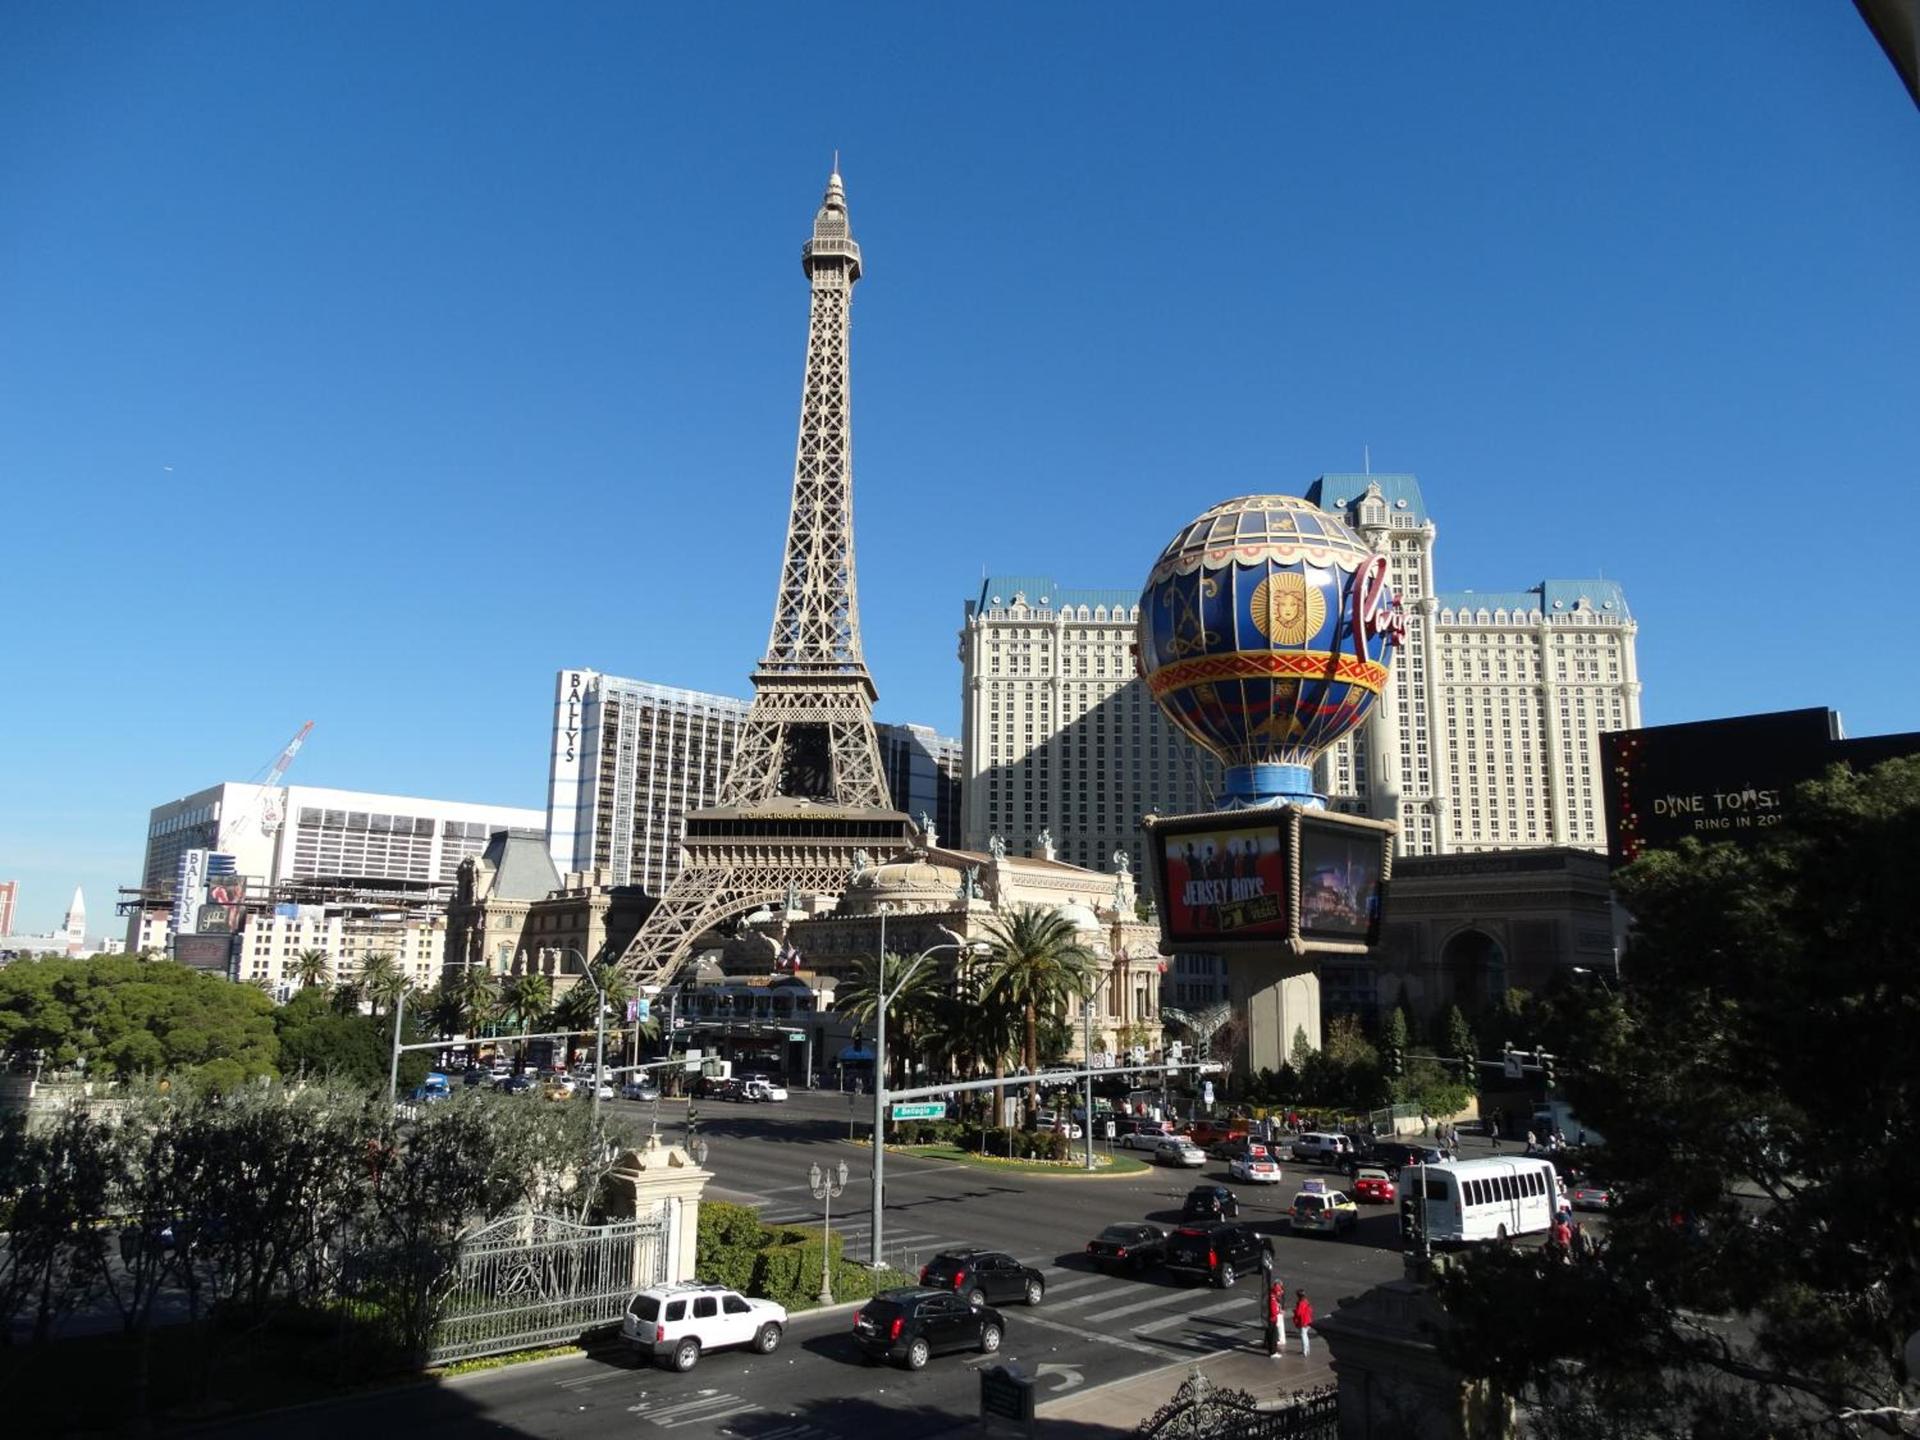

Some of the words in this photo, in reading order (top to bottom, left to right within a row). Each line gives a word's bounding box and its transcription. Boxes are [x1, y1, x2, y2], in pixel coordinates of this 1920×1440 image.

[1695, 817, 1730, 830] RING
[1736, 816, 1751, 828] IN
[1183, 879, 1228, 906] JERSEY
